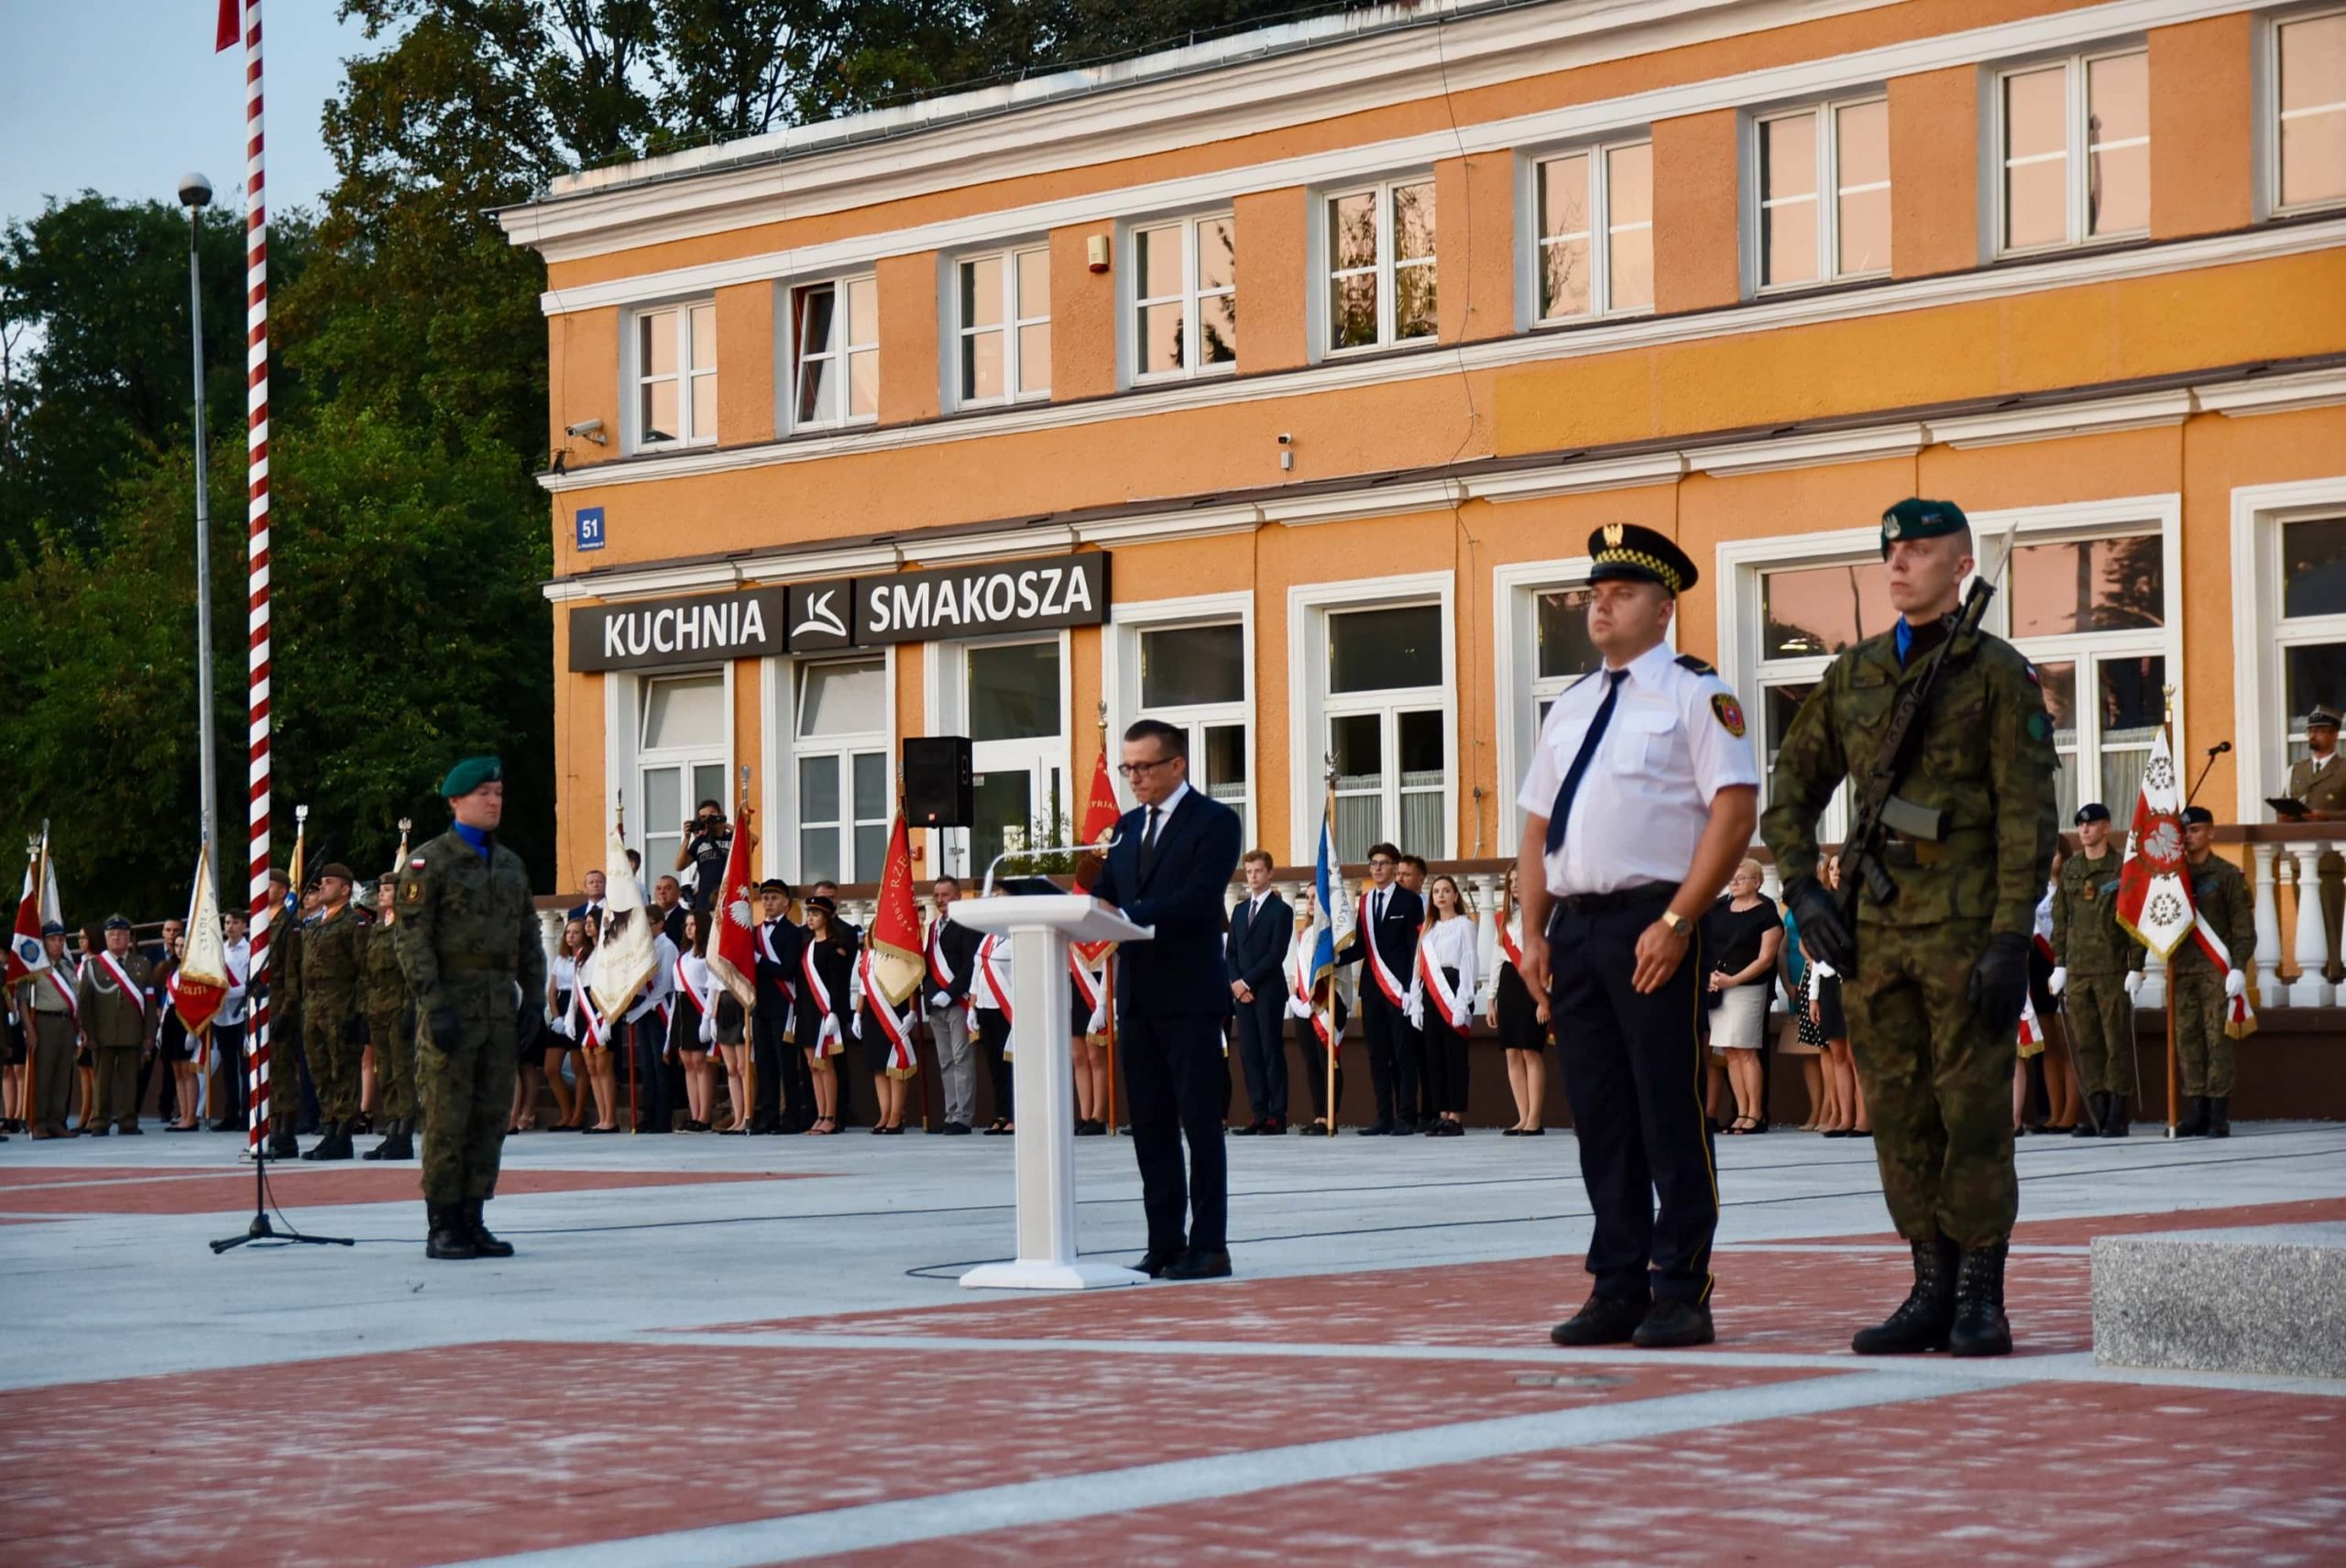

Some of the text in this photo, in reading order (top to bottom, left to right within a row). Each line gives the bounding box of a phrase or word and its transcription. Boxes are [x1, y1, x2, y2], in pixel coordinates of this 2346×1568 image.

[583, 519, 597, 539] 51
[605, 599, 766, 657] KUCHNIA
[869, 565, 1092, 632] SMAKOSZA
